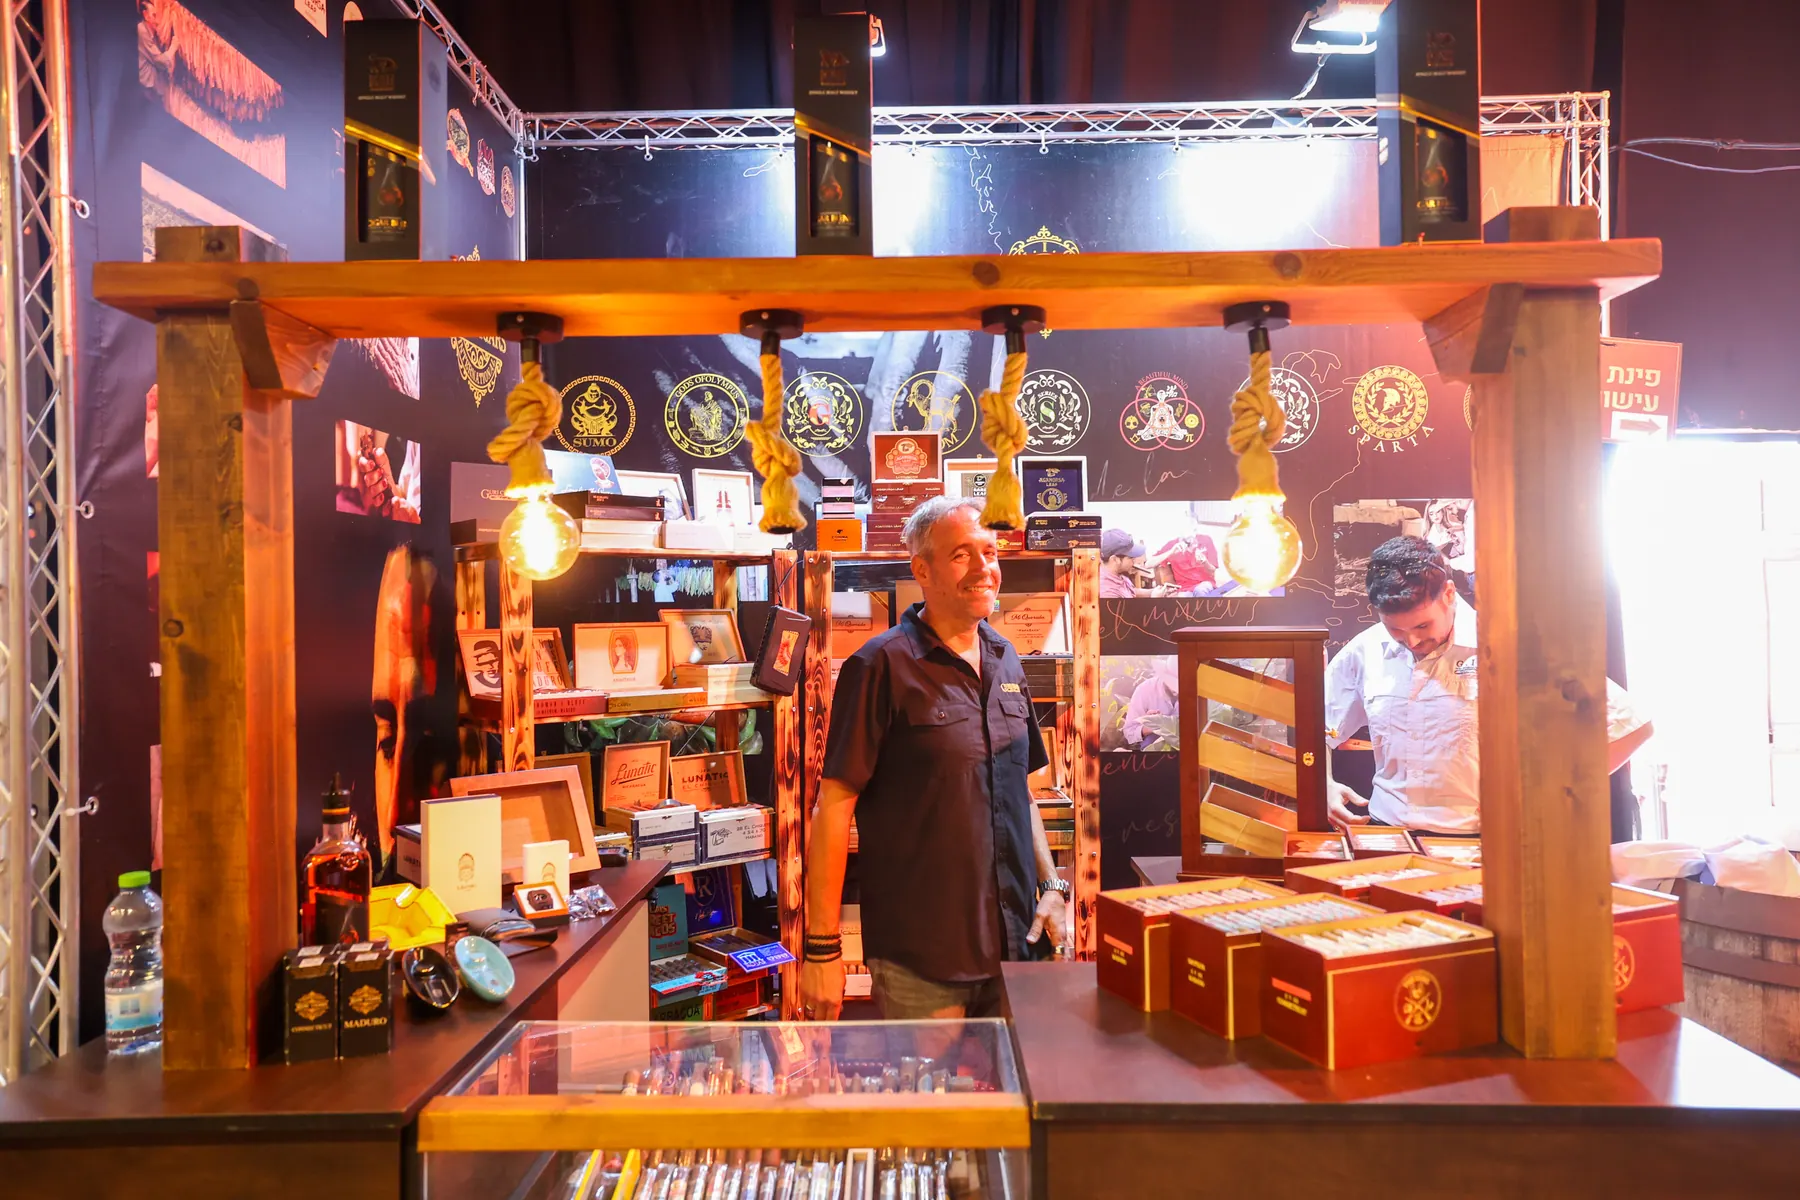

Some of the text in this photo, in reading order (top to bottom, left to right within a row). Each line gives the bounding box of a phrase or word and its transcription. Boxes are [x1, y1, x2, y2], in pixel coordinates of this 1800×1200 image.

[1138, 371, 1171, 385] BEAUTIFUL
[1172, 374, 1189, 390] MIND
[1606, 365, 1661, 387] פינת
[675, 379, 695, 398] GODS
[572, 436, 617, 448] SUMO
[1348, 423, 1435, 454] SPARTA
[610, 763, 657, 785] Lunatic
[681, 771, 729, 784] LUNATIC
[343, 1017, 388, 1029] MADURO
